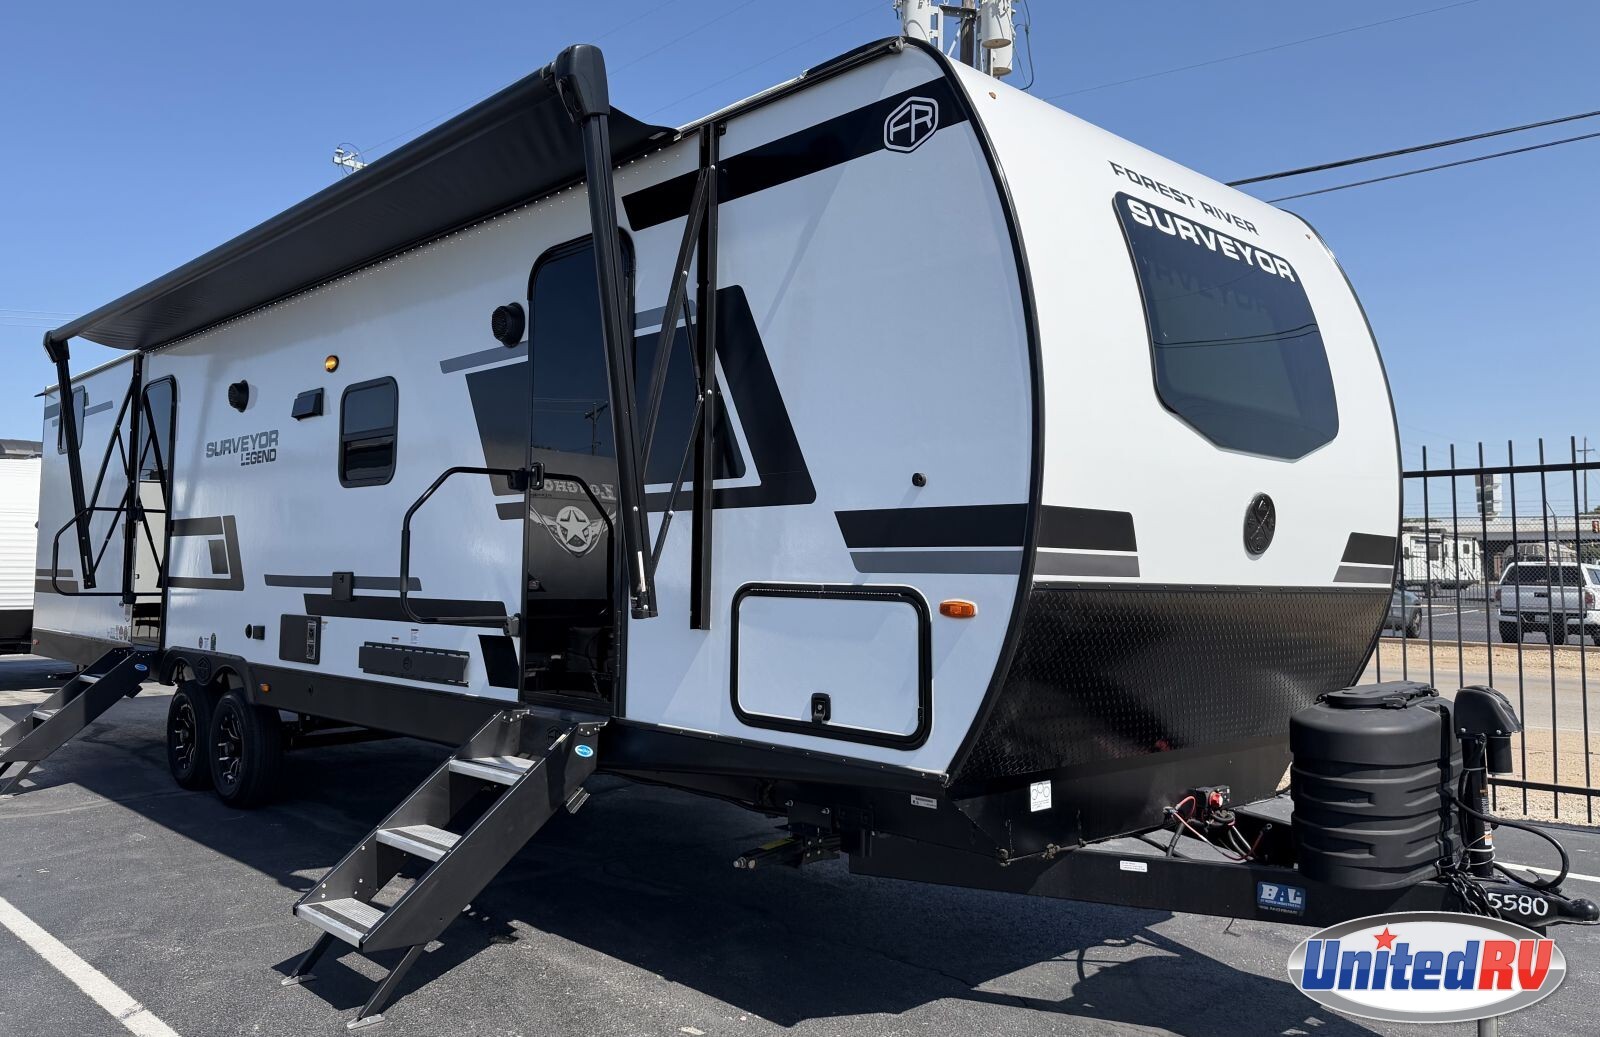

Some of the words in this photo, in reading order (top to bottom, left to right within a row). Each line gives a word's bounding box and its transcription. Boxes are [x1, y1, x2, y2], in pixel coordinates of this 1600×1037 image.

[1108, 160, 1196, 208] FOREST
[1198, 200, 1260, 236] RIVER
[1127, 199, 1296, 283] SURVEYOR
[206, 430, 279, 458] SURVEYOR
[241, 448, 277, 467] LEGEND
[1487, 892, 1549, 916] 5580
